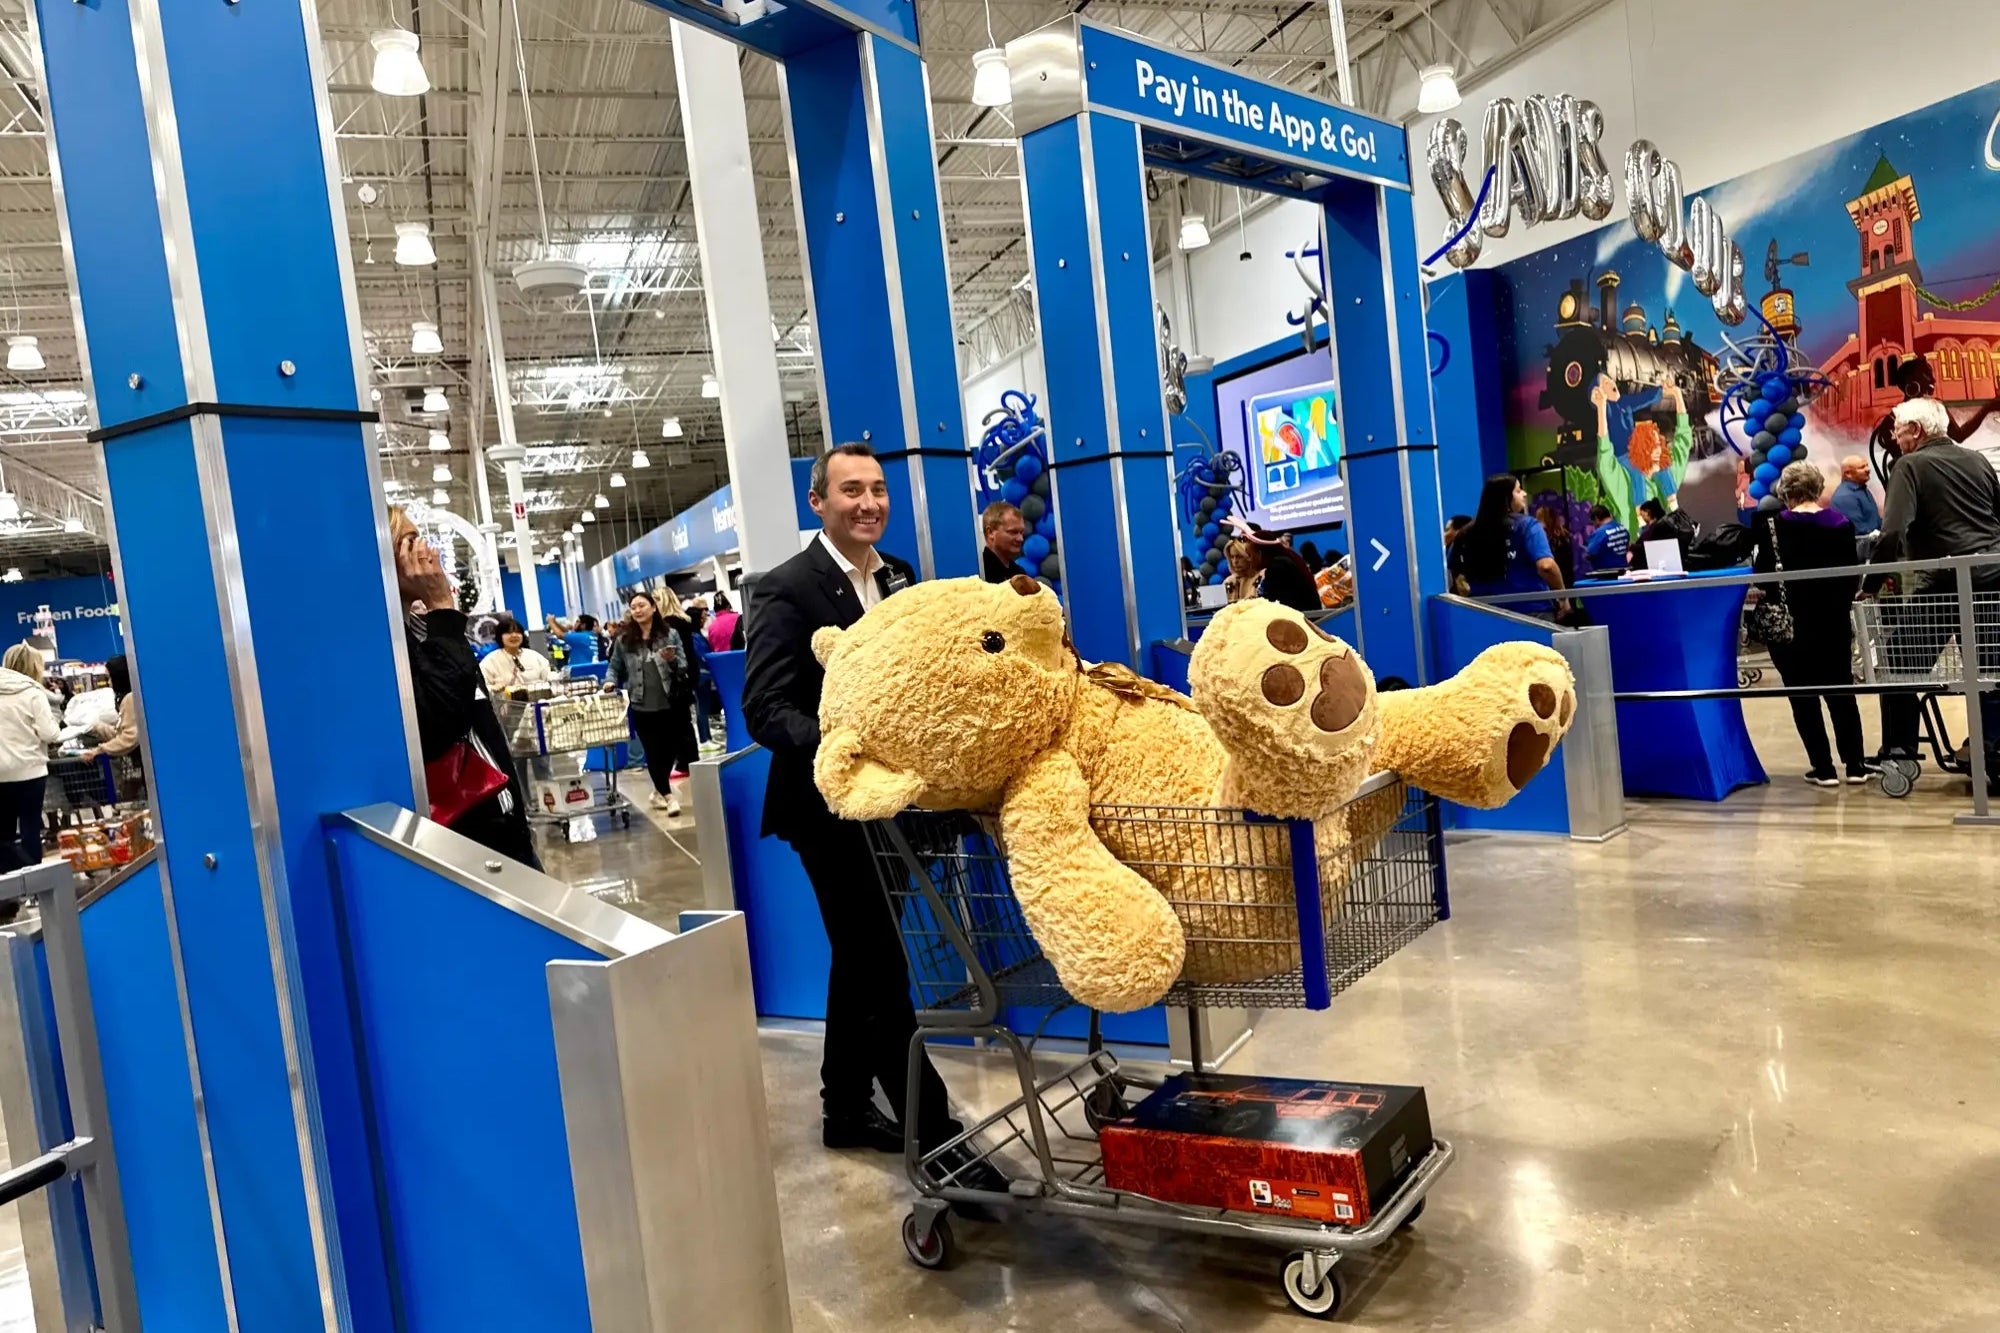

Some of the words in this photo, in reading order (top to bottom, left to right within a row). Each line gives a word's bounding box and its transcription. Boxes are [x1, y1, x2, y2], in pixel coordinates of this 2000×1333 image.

[1135, 58, 1187, 117] Pay
[1191, 75, 1218, 119] in
[1222, 89, 1264, 131] the
[1268, 101, 1316, 152] App
[1320, 117, 1339, 152] &
[1340, 124, 1377, 163] Go!
[17, 607, 72, 624] Fren
